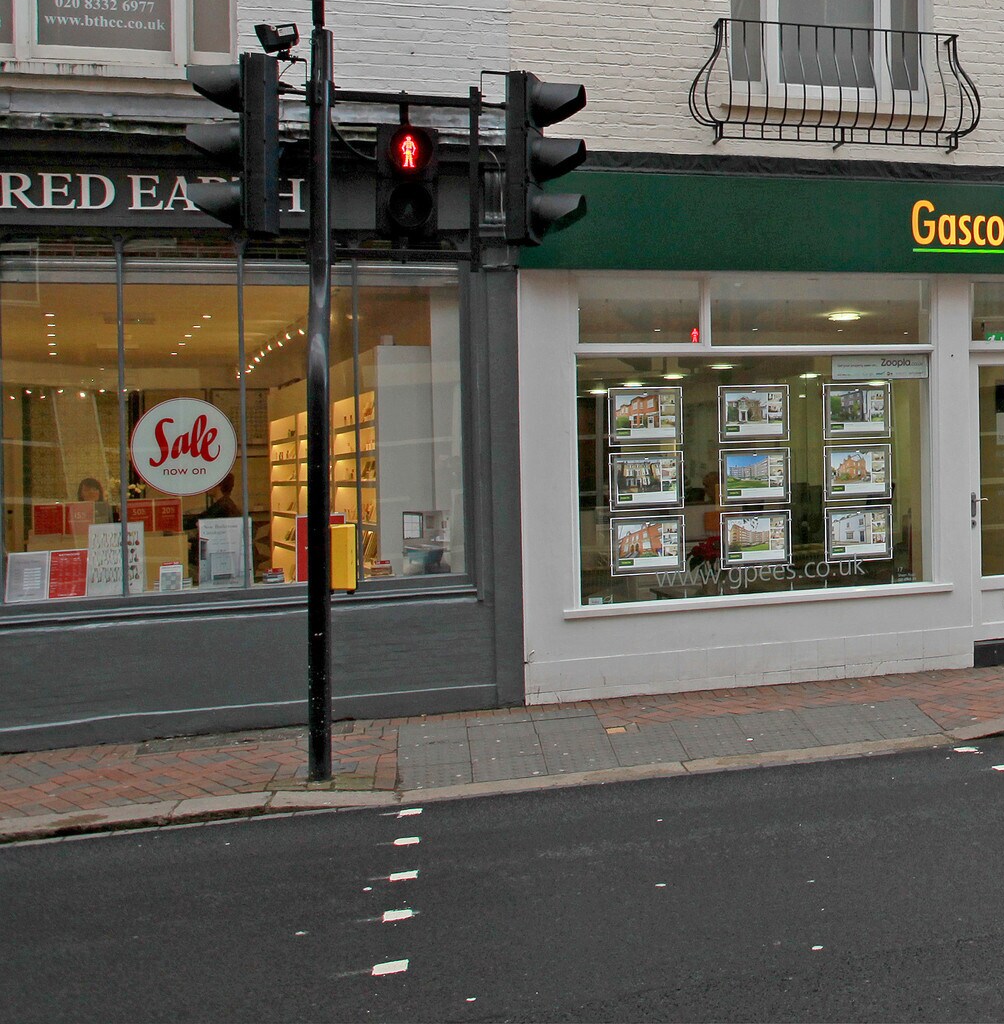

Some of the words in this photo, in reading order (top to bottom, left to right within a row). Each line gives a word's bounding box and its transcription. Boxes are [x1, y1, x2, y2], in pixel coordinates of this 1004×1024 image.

[122, 0, 154, 13] 6977
[44, 15, 166, 31] www.bthcc.co.uk
[0, 172, 116, 210] RED
[127, 174, 306, 213] EAH
[149, 414, 221, 467] Sale
[163, 468, 188, 476] now
[655, 553, 867, 589] www.gpees.co.uk
